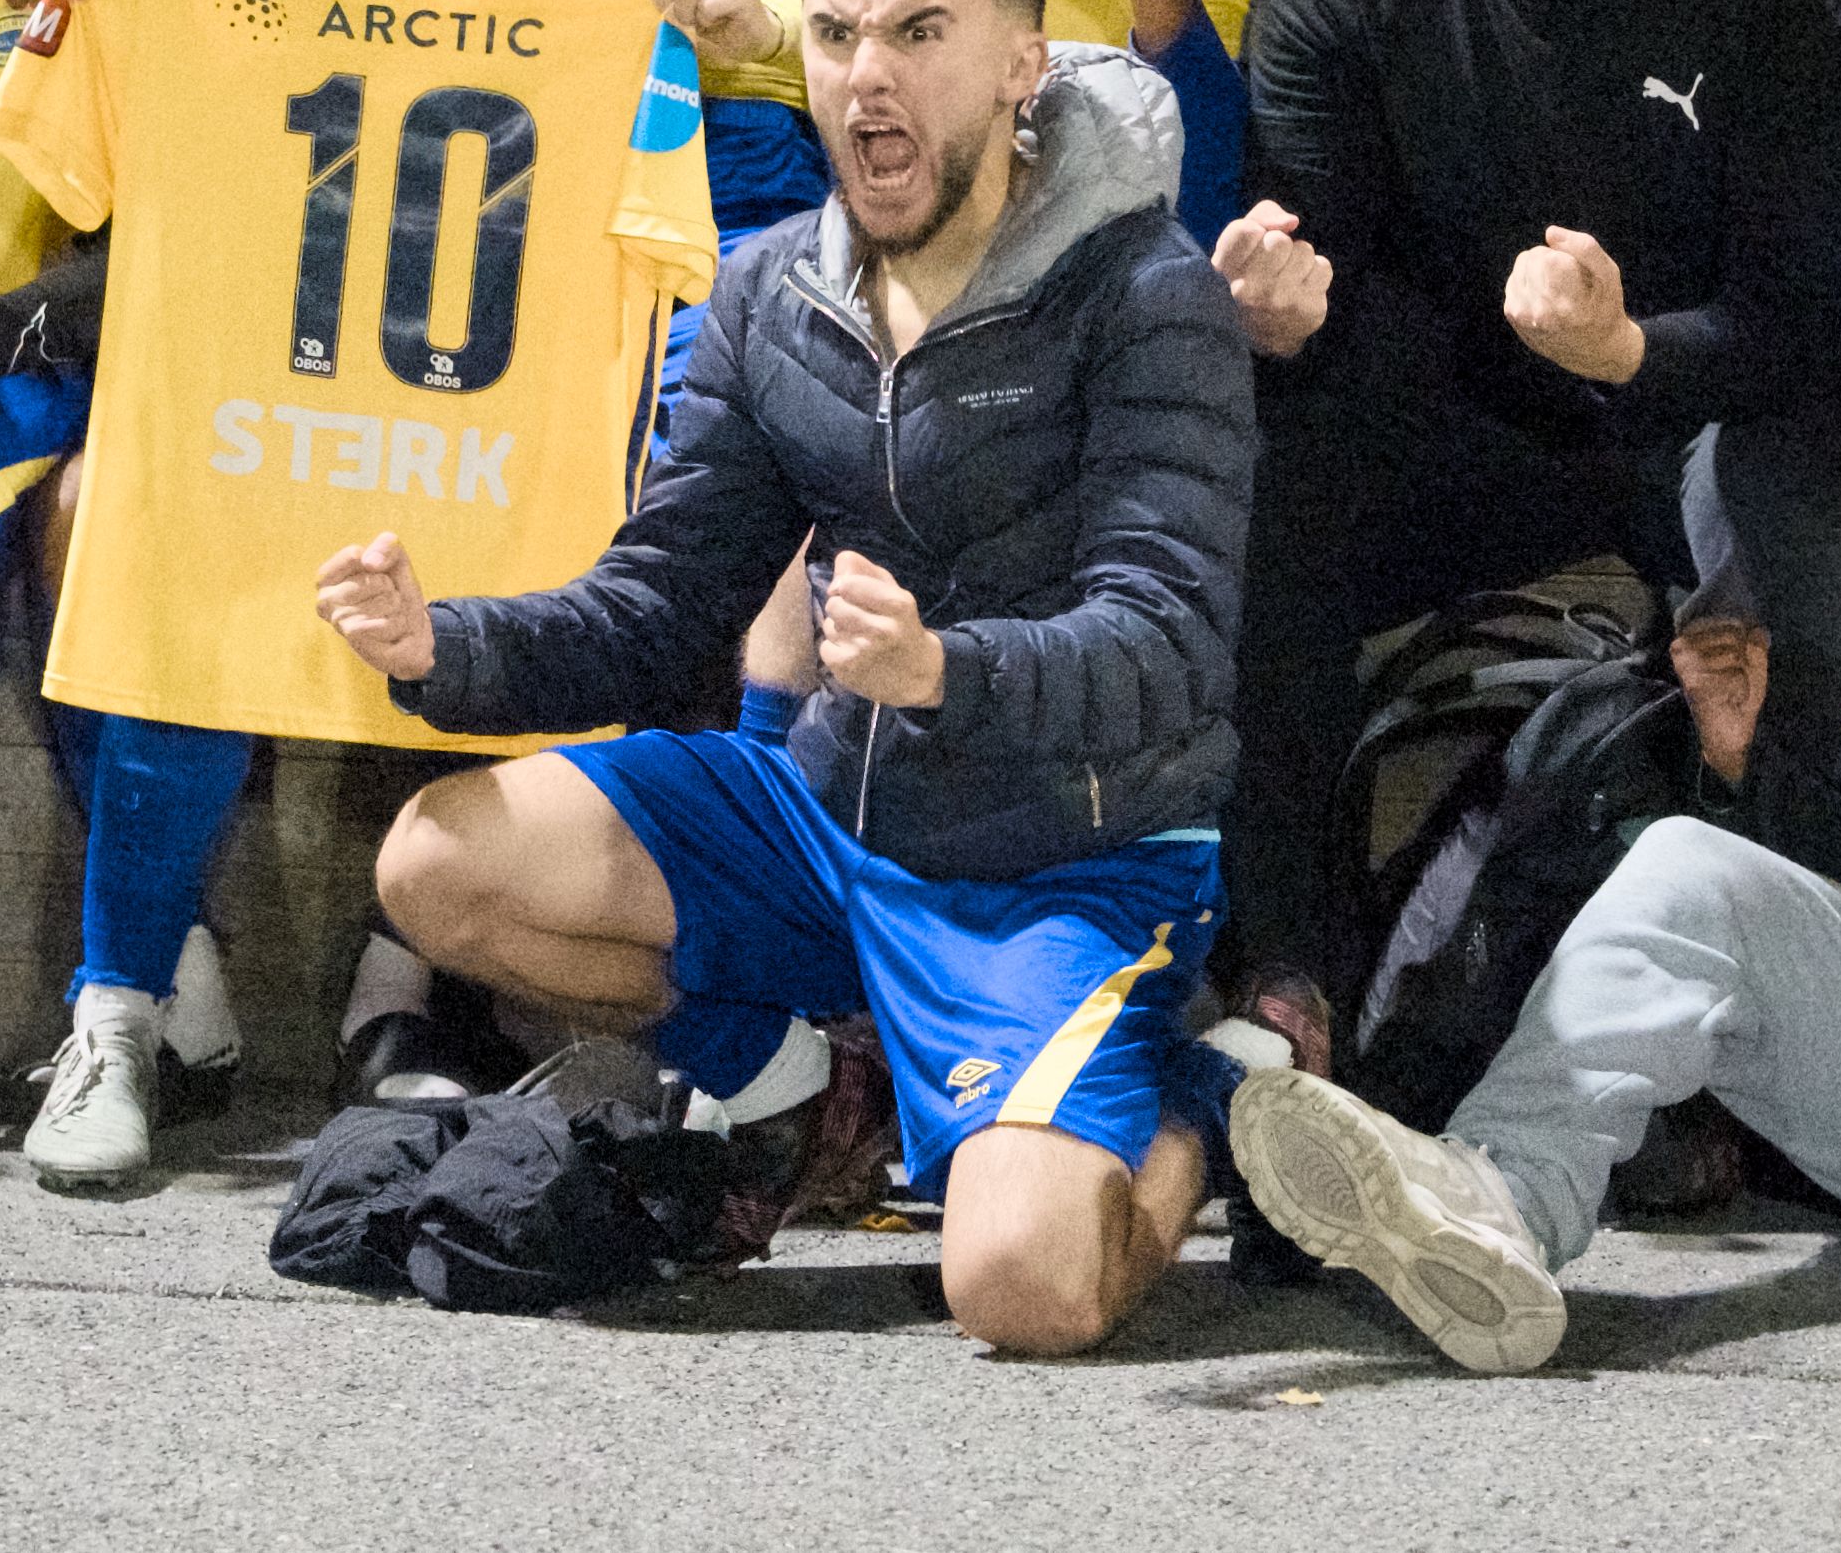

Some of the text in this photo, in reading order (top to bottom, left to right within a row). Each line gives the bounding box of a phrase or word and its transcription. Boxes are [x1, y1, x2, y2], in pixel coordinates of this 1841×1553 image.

[317, 0, 545, 58] ARCTIC
[284, 71, 538, 395] 10
[293, 356, 332, 373] OBOS
[423, 373, 462, 389] OBOS
